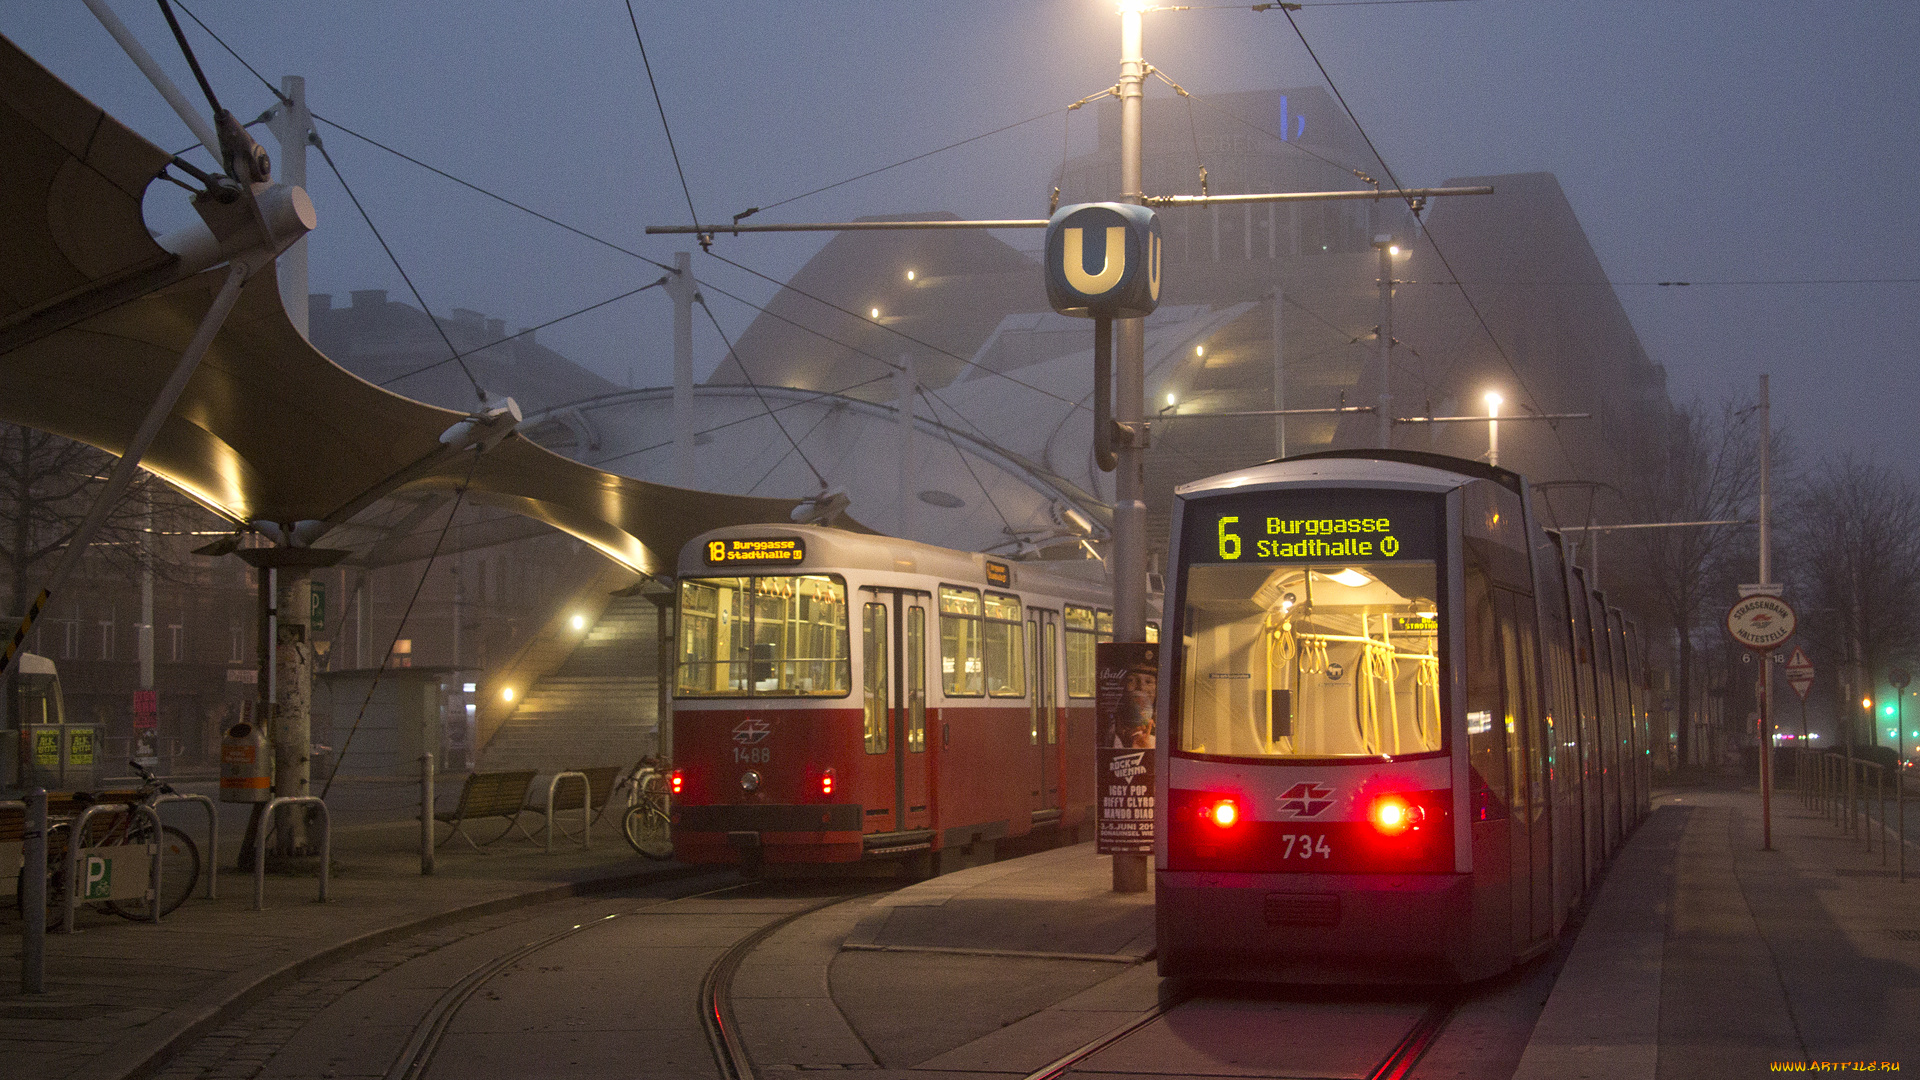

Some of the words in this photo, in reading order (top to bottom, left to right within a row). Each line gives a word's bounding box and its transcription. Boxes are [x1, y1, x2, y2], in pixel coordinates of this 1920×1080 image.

[1063, 226, 1125, 294] U
[1148, 230, 1161, 301] U
[1267, 517, 1389, 535] Burggasse
[733, 541, 795, 550] Burggasse
[1218, 516, 1241, 560] 6
[709, 541, 725, 561] 18
[727, 550, 791, 560] Stadthalle
[1257, 538, 1372, 557] Stadthalle
[312, 593, 320, 616] P
[1734, 601, 1788, 620] STRASSENBAHN
[1737, 626, 1787, 643] HALTESTELLE
[1742, 653, 1751, 663] 6
[1774, 654, 1784, 663] 18
[733, 747, 770, 763] 1488
[1109, 759, 1131, 771] ROCK
[1114, 766, 1147, 778] VIENNA
[1109, 785, 1127, 796] IGGY
[1130, 785, 1147, 796] POP
[1104, 797, 1124, 807] BIFFY
[1127, 797, 1154, 808] CLYRO
[1104, 809, 1132, 819] MANDO
[1282, 834, 1331, 859] 734
[85, 857, 105, 896] P
